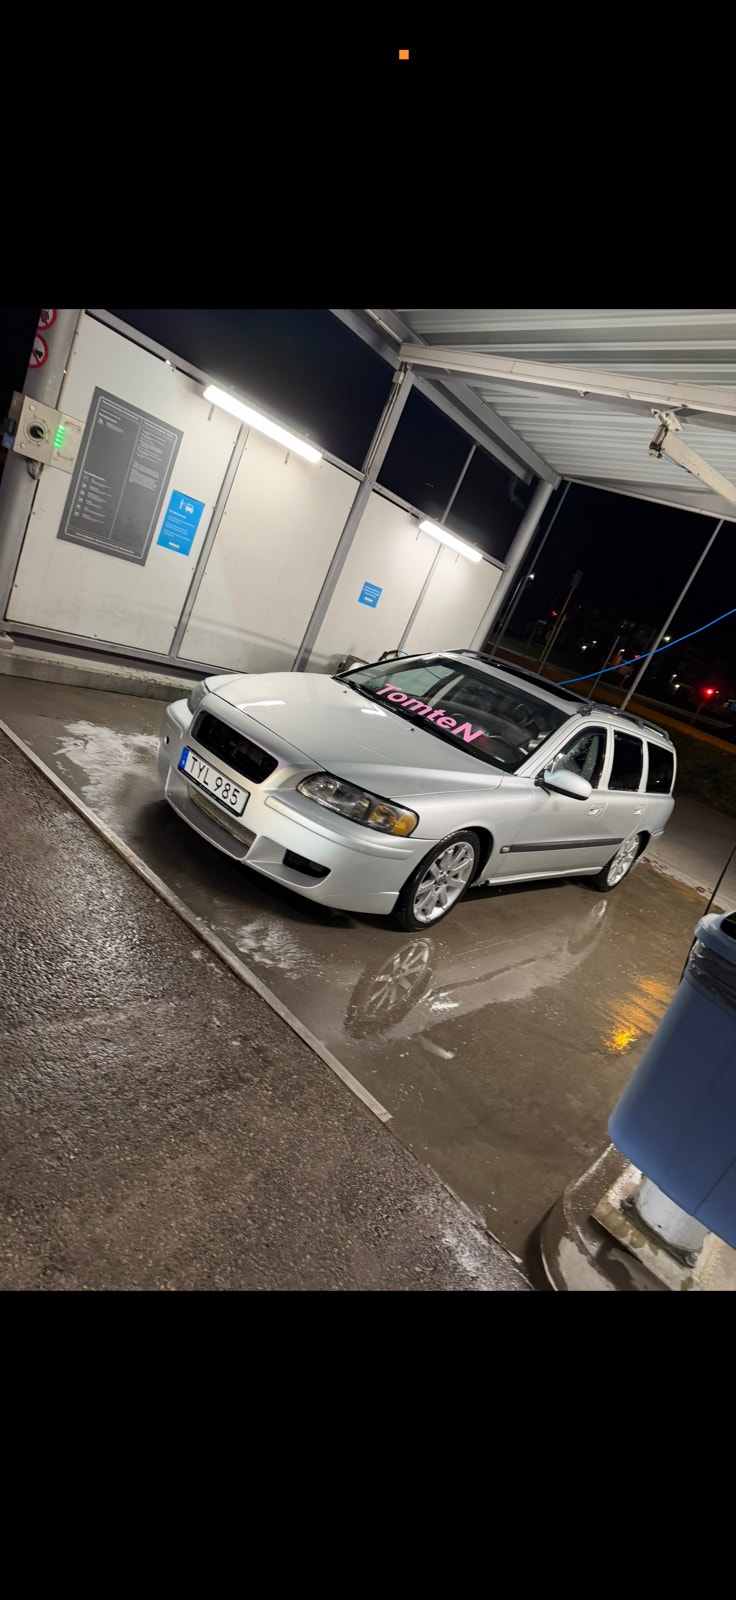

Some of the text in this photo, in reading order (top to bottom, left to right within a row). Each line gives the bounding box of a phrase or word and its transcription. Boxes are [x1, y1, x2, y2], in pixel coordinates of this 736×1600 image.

[375, 683, 485, 743] TomteN
[190, 756, 209, 786] TYL
[213, 777, 240, 806] 985
